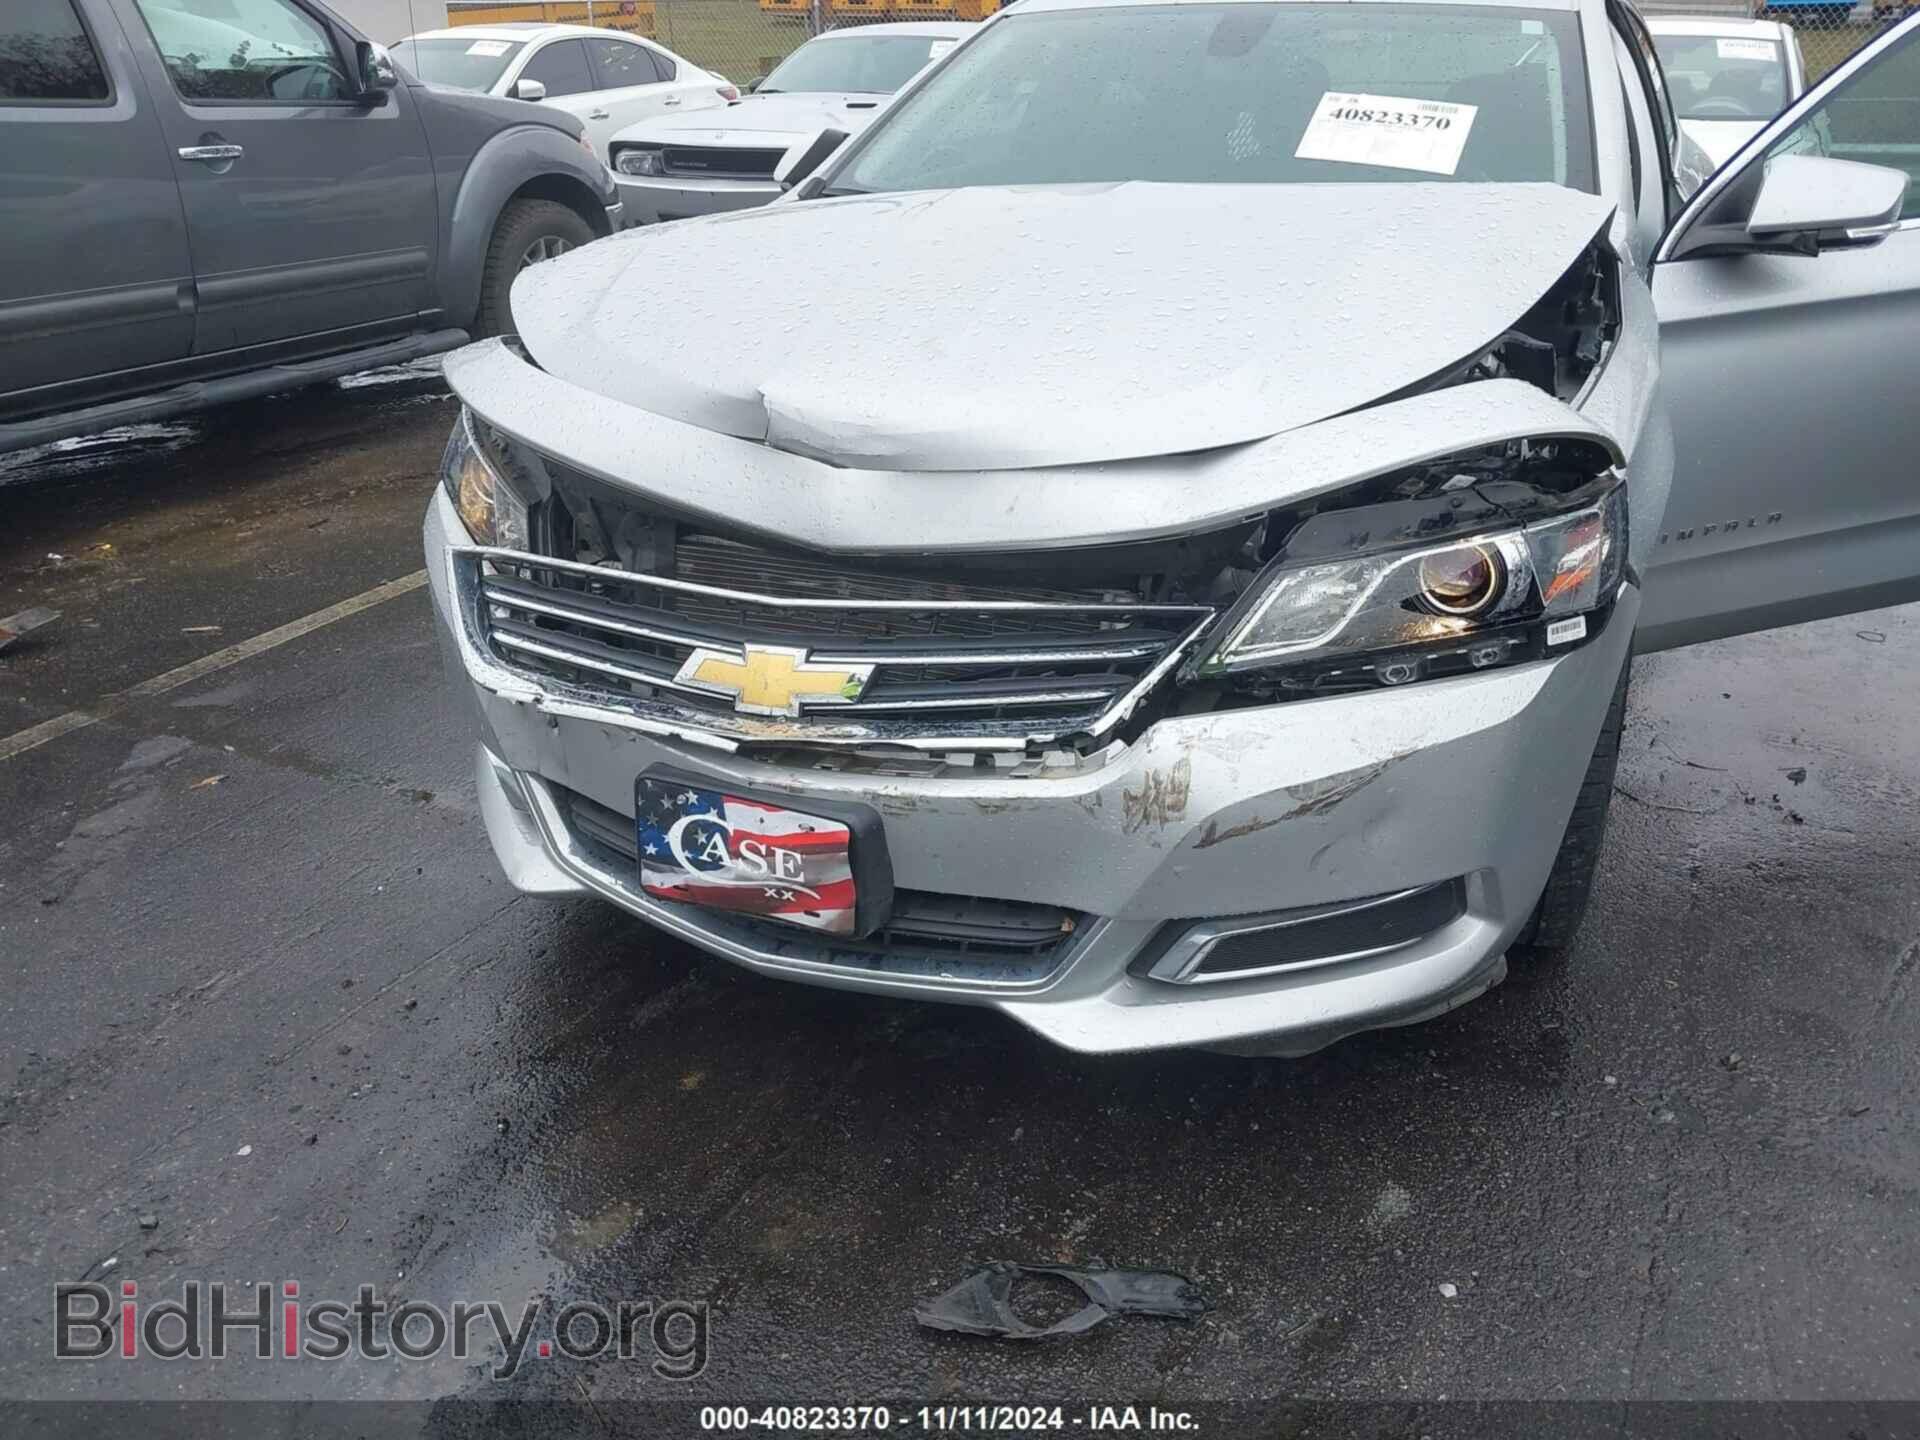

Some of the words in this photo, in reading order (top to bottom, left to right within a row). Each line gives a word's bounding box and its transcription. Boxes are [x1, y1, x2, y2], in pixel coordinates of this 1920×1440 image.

[1328, 107, 1450, 130] 40823370
[1660, 511, 1783, 544] IMPALA
[667, 813, 806, 884] CASE
